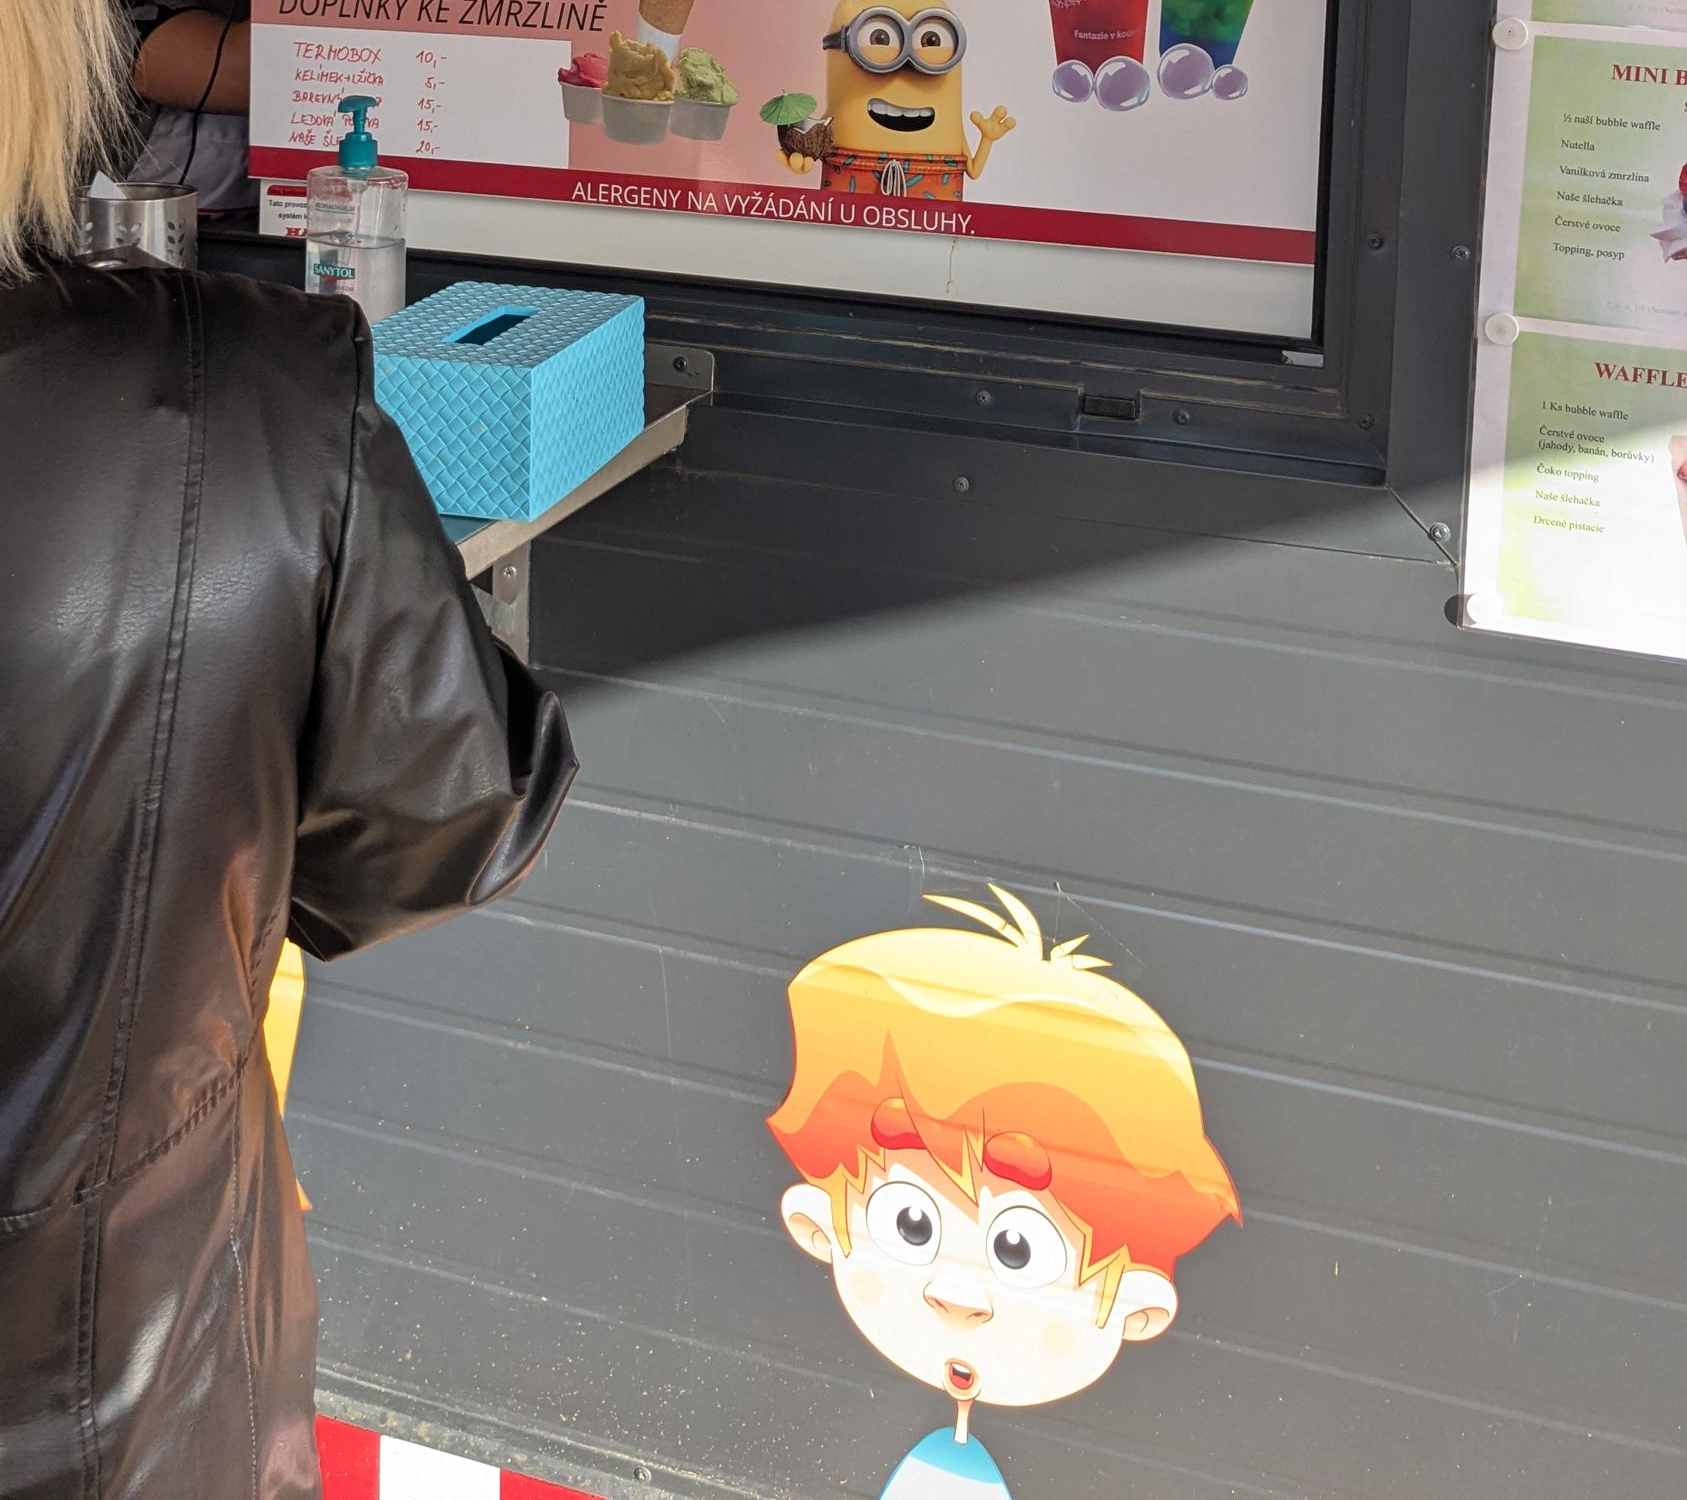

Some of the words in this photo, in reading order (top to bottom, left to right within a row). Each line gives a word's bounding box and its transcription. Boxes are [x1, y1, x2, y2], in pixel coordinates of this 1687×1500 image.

[293, 41, 382, 64] TERMOBOX
[416, 50, 447, 69] 10,-
[425, 76, 446, 90] 5,-
[1611, 63, 1668, 86] MINI
[417, 97, 443, 113] 15,-
[416, 118, 439, 133] 15,-
[1595, 116, 1628, 129] bubble
[1630, 119, 1661, 131] waffle
[416, 139, 441, 155] 20,-
[1561, 139, 1595, 152] Nutella
[1559, 164, 1606, 179] Vanilková
[1608, 169, 1650, 183] zmrzlina
[1557, 190, 1580, 203] Naše
[1582, 191, 1623, 206] šlehačka
[572, 181, 682, 209] ALERGENY
[688, 191, 718, 211] NA
[724, 191, 834, 222] VYŽÁDÁNÍ
[840, 205, 856, 223] U
[863, 205, 977, 235] OBSLUHY.
[1554, 214, 1590, 230] Čerstvé
[1592, 222, 1621, 233] ovoce
[1596, 248, 1625, 261] posyp
[313, 263, 354, 279] SANYTOL
[1594, 362, 1687, 389] WAFFLE
[1550, 402, 1563, 413] Ks
[1565, 403, 1597, 417] bubble
[1599, 409, 1629, 421] waffle
[1539, 424, 1575, 440] Čerstvé
[1577, 432, 1605, 443] ovoce
[1538, 440, 1577, 455] (jahody,
[1578, 444, 1608, 458] banán,
[1611, 448, 1656, 464] borůvky)
[1536, 463, 1562, 477] Čoko
[1564, 469, 1600, 483] topping
[1535, 490, 1559, 503] Naše
[1560, 493, 1600, 508] šlehačka
[1533, 515, 1567, 529] Drcené
[1568, 518, 1605, 533] pistacie
